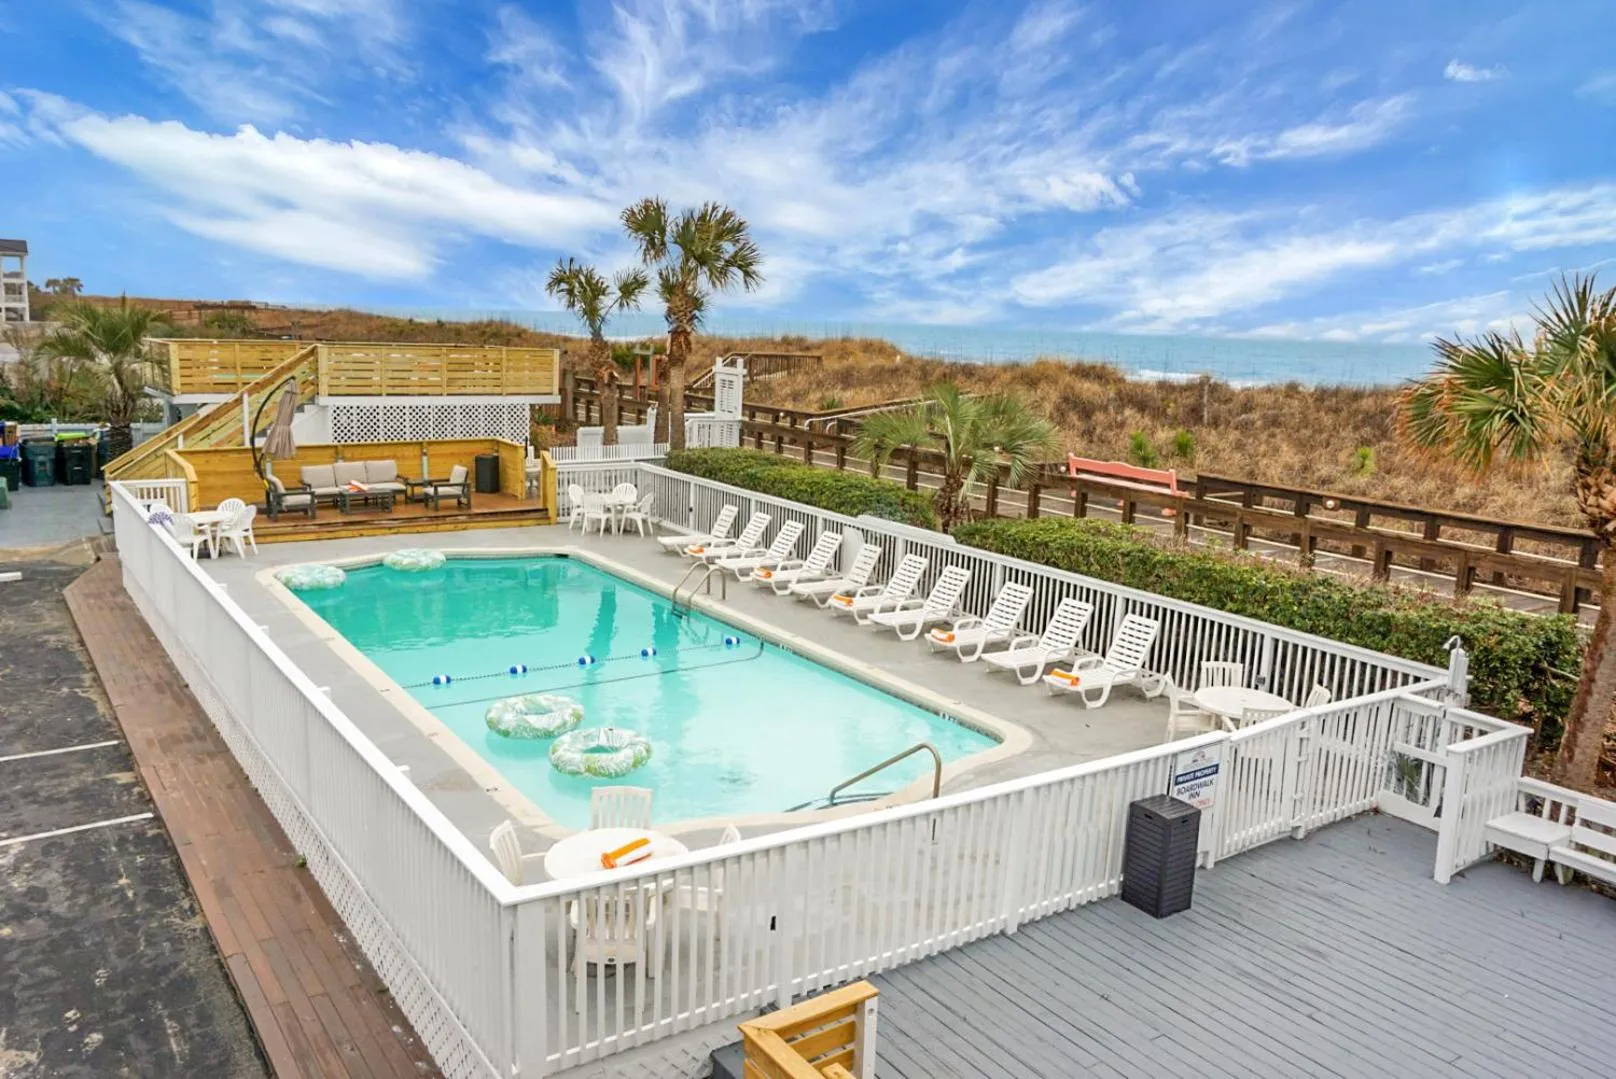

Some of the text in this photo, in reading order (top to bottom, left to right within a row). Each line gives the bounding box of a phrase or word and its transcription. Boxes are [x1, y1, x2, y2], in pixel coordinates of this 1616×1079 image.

[1176, 767, 1217, 784] PRIVATE PROPERTY
[1176, 779, 1214, 796] BOARDWALK
[1188, 791, 1200, 800] INN
